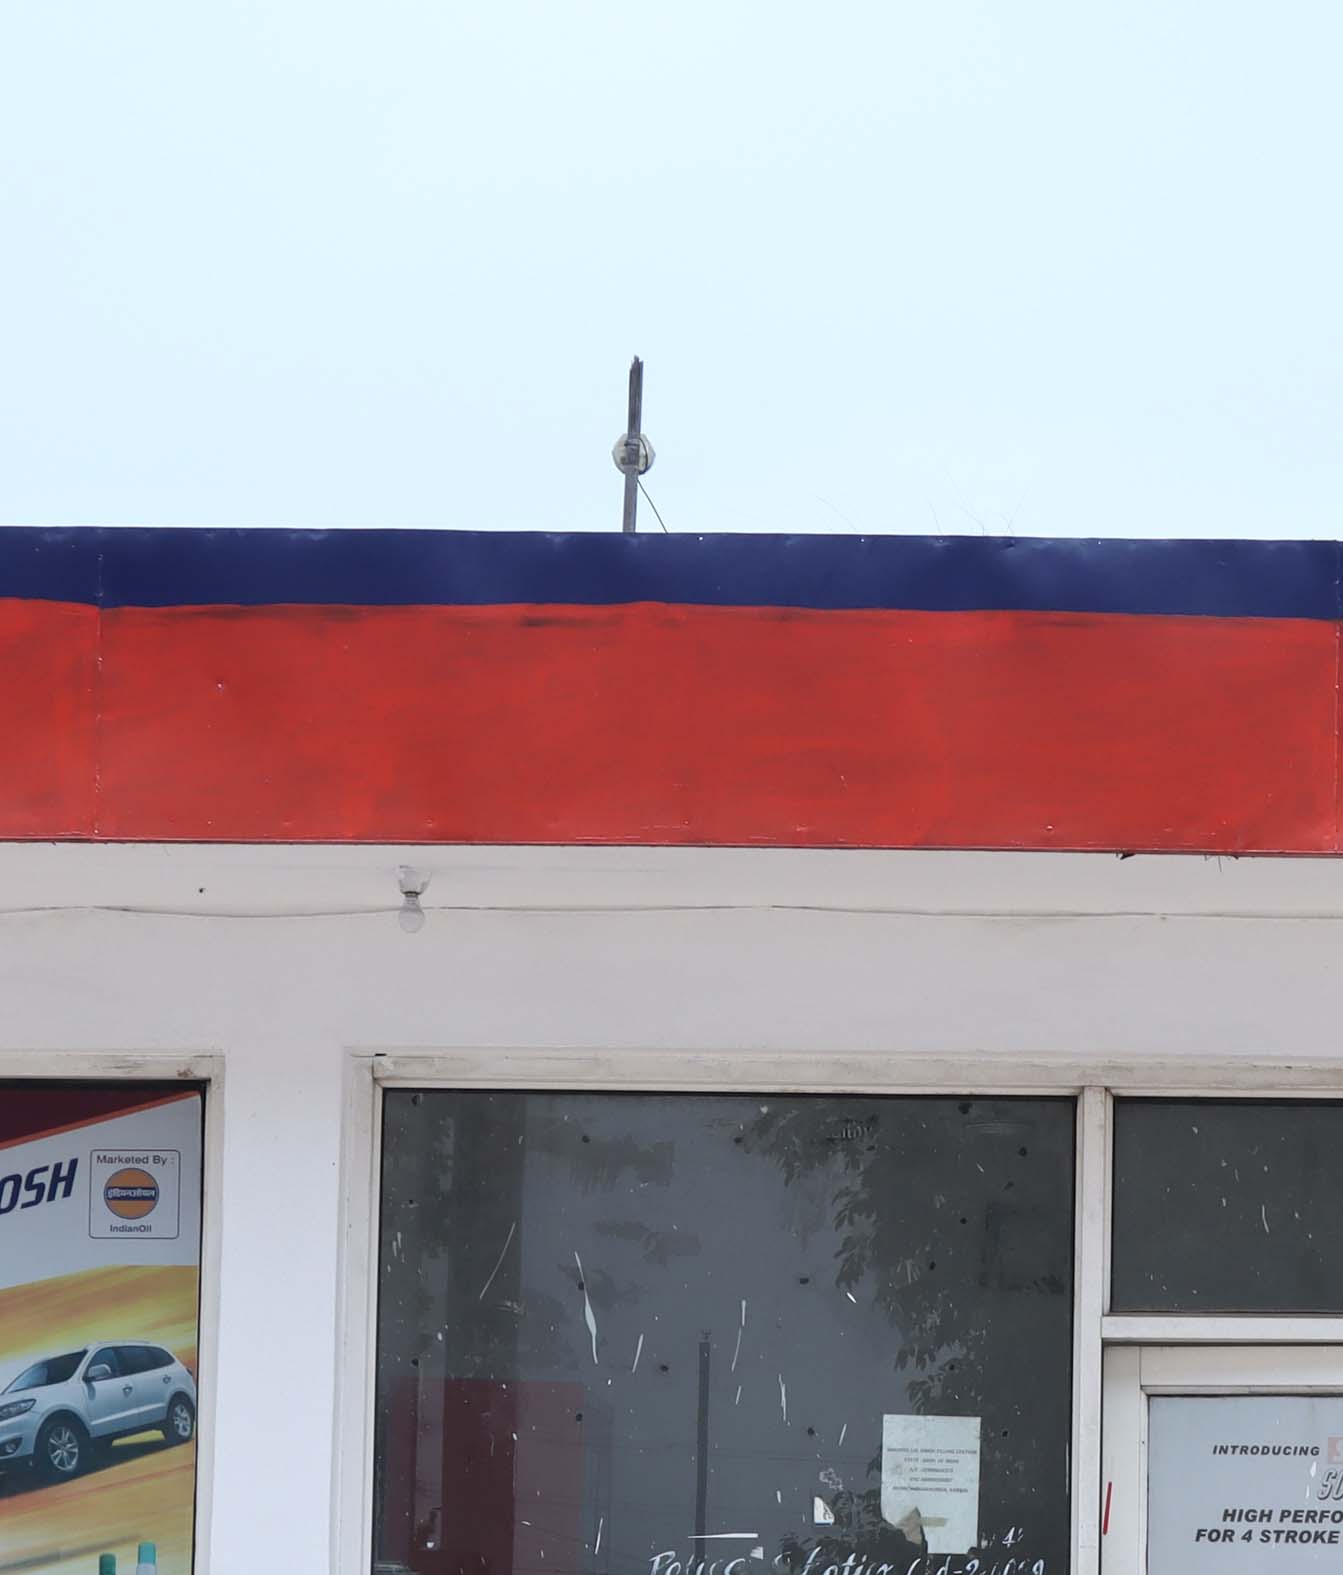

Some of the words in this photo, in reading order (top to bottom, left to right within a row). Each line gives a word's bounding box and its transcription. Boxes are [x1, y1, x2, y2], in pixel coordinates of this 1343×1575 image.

[97, 1155, 149, 1164] Marketed
[152, 1155, 167, 1165] By
[110, 1225, 151, 1233] IndianOil
[1212, 1445, 1320, 1457] INTRODUCING
[1222, 1508, 1273, 1523] HIGH
[1195, 1529, 1236, 1542] FOR
[1241, 1530, 1253, 1543] 4
[1260, 1529, 1340, 1544] STROKE
